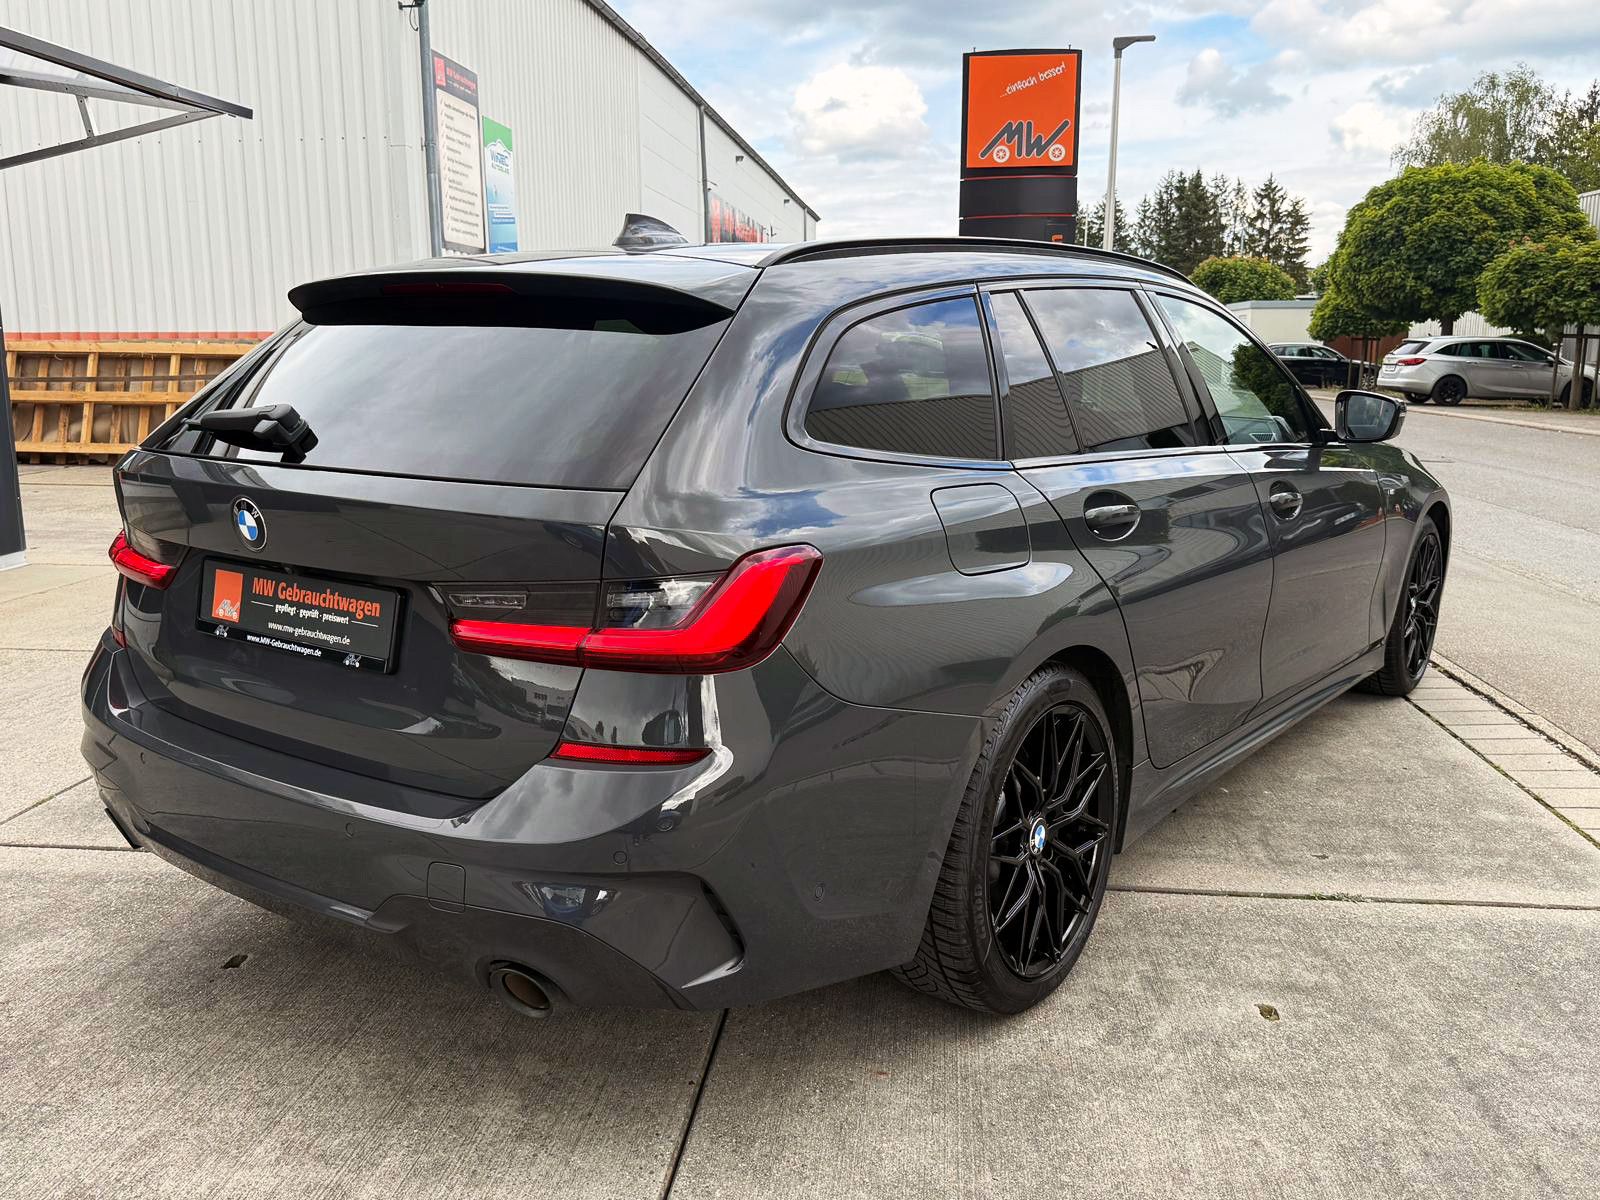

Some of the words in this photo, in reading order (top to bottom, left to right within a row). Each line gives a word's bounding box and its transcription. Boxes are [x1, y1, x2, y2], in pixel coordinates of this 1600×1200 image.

[979, 119, 1071, 160] MW
[252, 577, 276, 597] MW
[278, 581, 381, 620] Gebrauchtwagen
[322, 613, 349, 625] preiswert
[246, 634, 322, 658] www.MW-Gebrauchtwagen.de
[267, 621, 351, 646] www.mw-gebrauchtwagen.de
